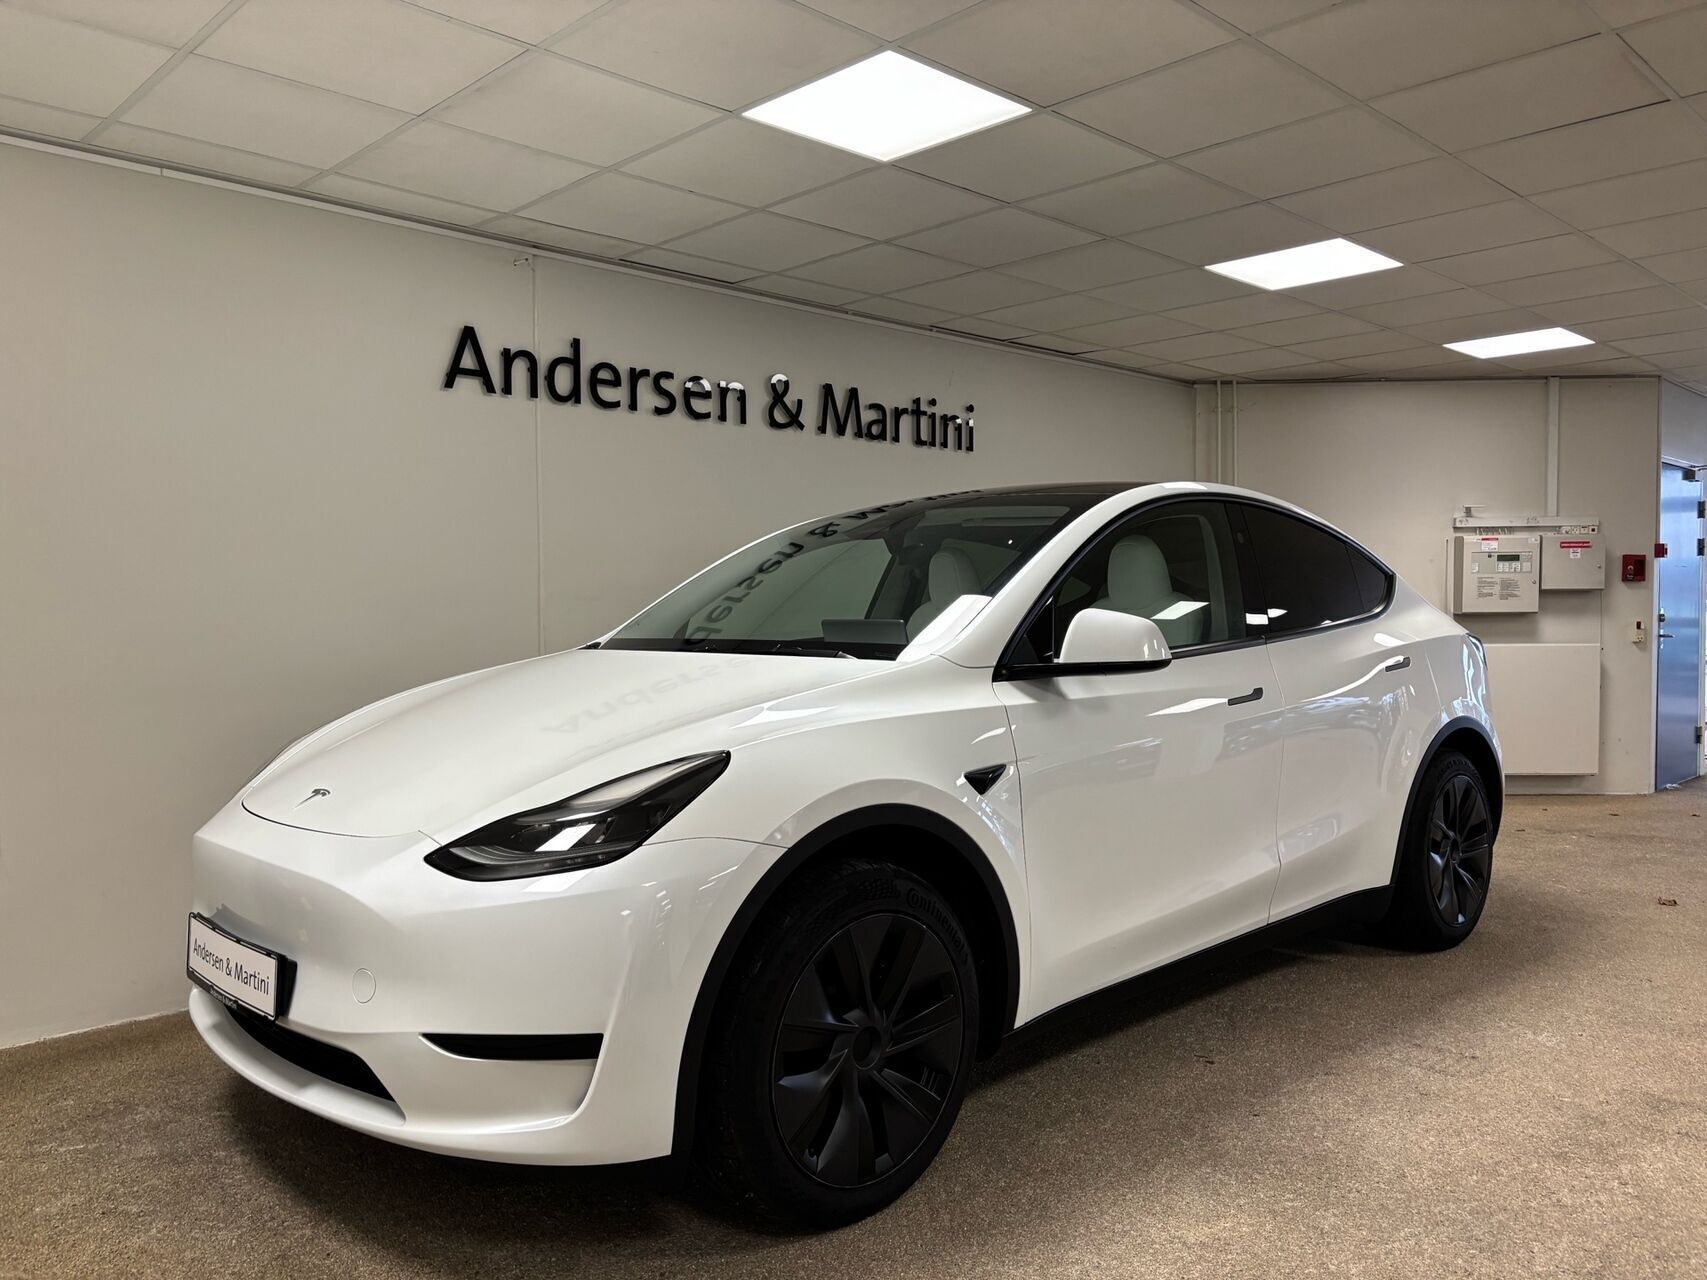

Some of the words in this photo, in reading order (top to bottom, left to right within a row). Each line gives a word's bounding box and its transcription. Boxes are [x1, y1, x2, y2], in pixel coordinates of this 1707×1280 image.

[444, 325, 747, 425] Andersen
[767, 373, 805, 431] &
[817, 382, 975, 452] Martini
[193, 938, 224, 973] Andersen
[225, 957, 233, 976] &
[233, 962, 270, 995] Martini
